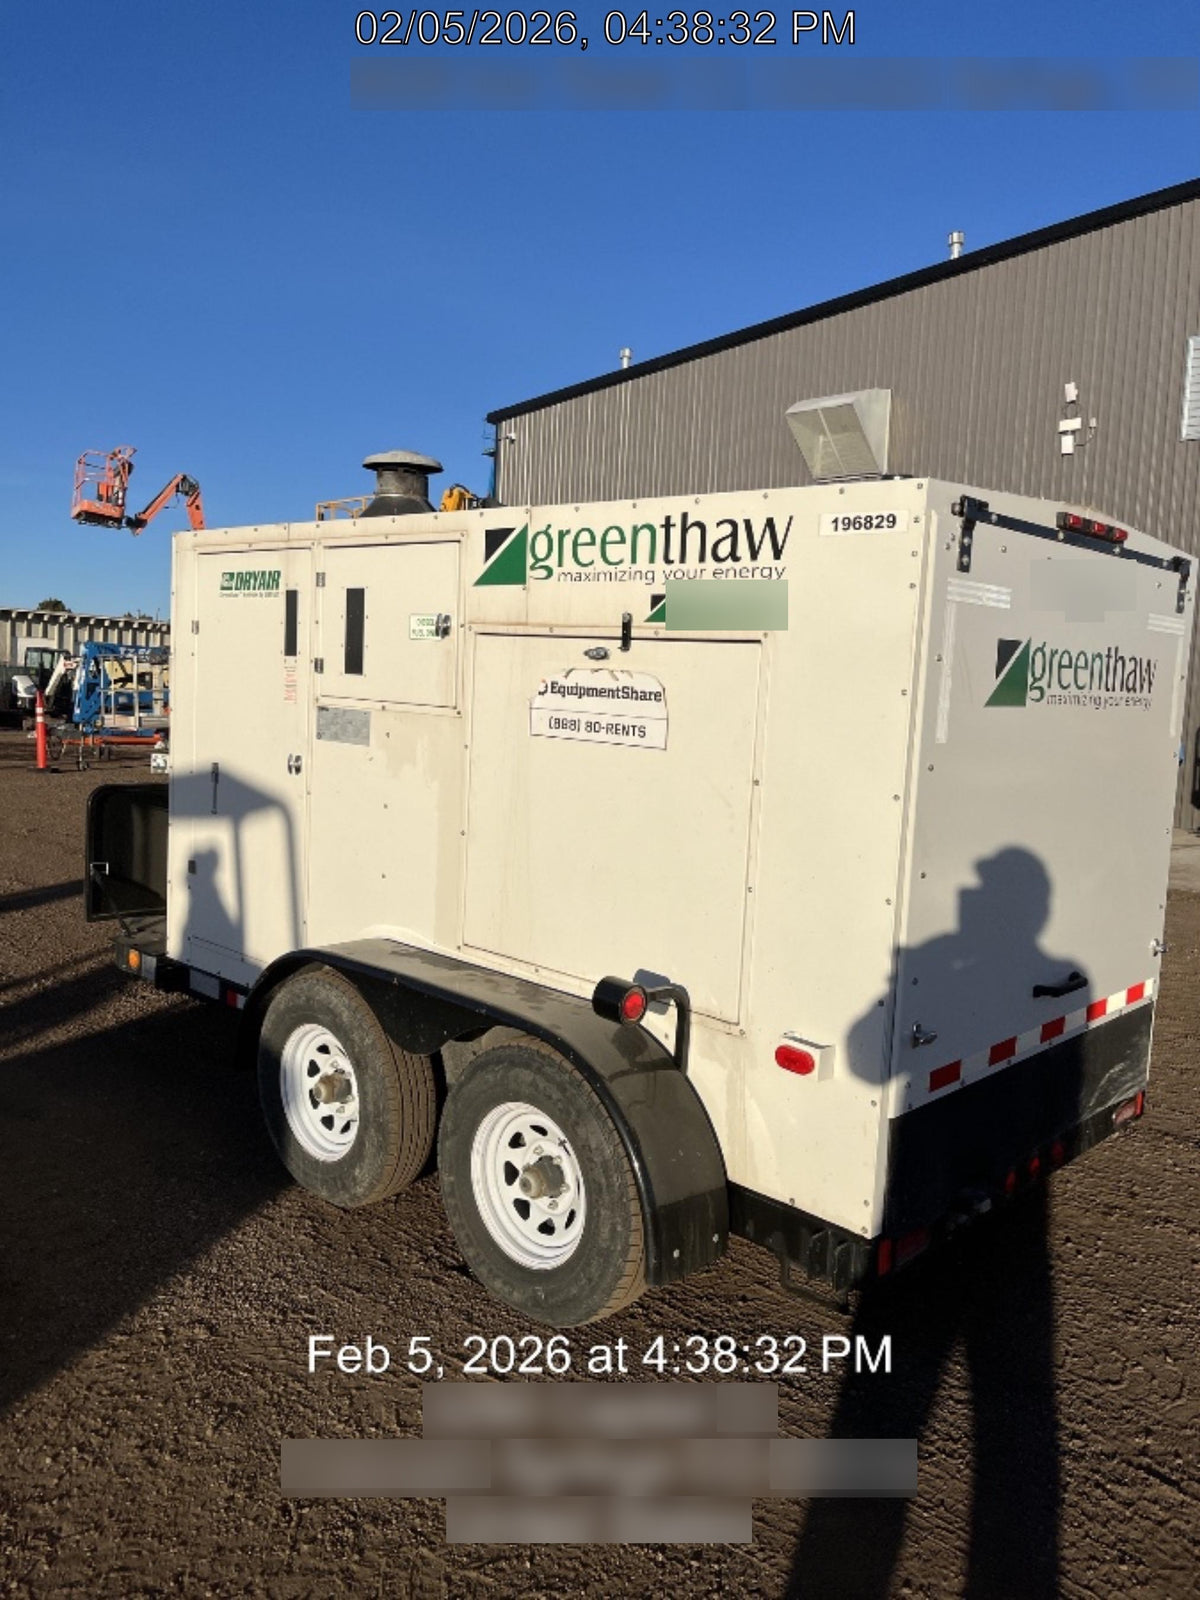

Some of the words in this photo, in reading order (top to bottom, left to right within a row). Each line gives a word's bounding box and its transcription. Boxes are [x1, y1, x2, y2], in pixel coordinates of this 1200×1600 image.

[830, 513, 897, 532] 196829
[529, 511, 794, 580] greenthaw
[234, 570, 281, 591] DRYAIR
[557, 566, 656, 586] maximizing
[662, 567, 707, 586] your
[712, 565, 787, 580] energy
[1029, 641, 1158, 703] greenthaw
[550, 681, 662, 702] EquipmentShare
